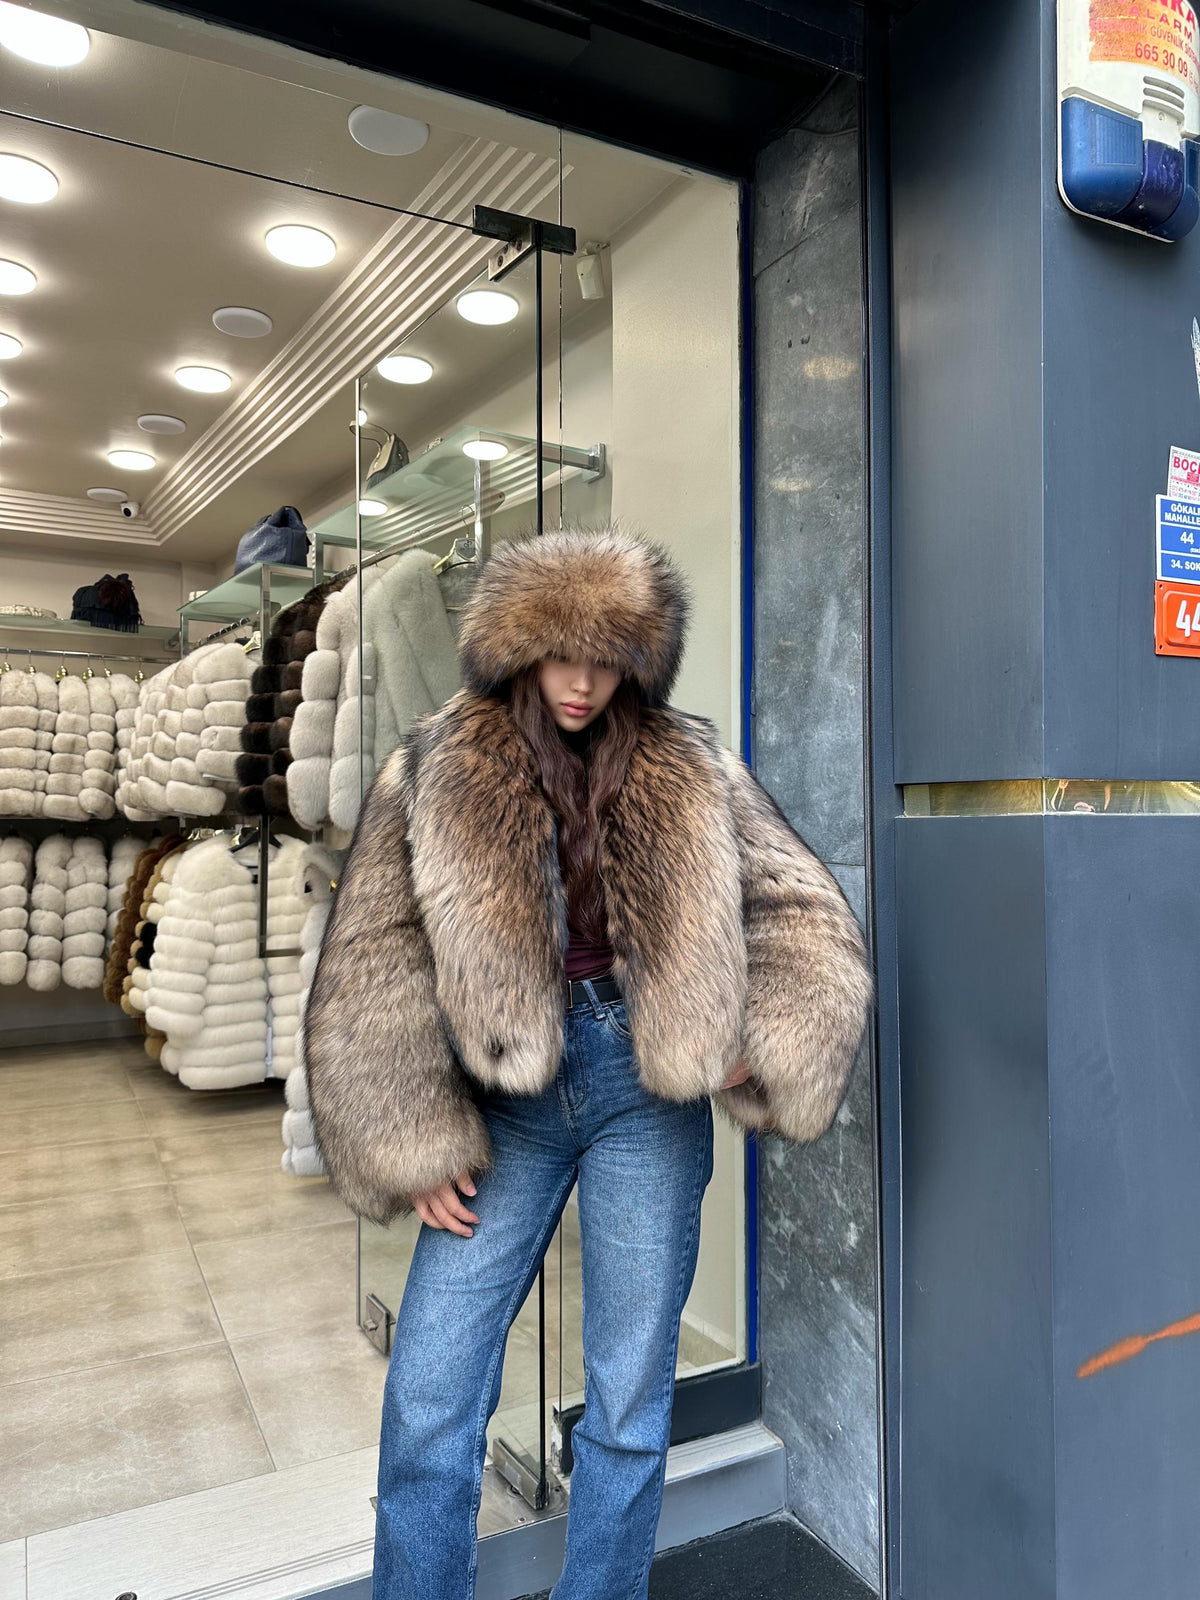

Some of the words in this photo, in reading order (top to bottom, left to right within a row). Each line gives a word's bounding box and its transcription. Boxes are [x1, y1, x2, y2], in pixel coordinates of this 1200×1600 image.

[1129, 5, 1193, 42] ALARM
[1135, 42, 1159, 62] 665
[1162, 49, 1175, 69] 30
[1178, 57, 1188, 77] 09
[1180, 531, 1194, 545] 44
[1170, 559, 1183, 569] 34.
